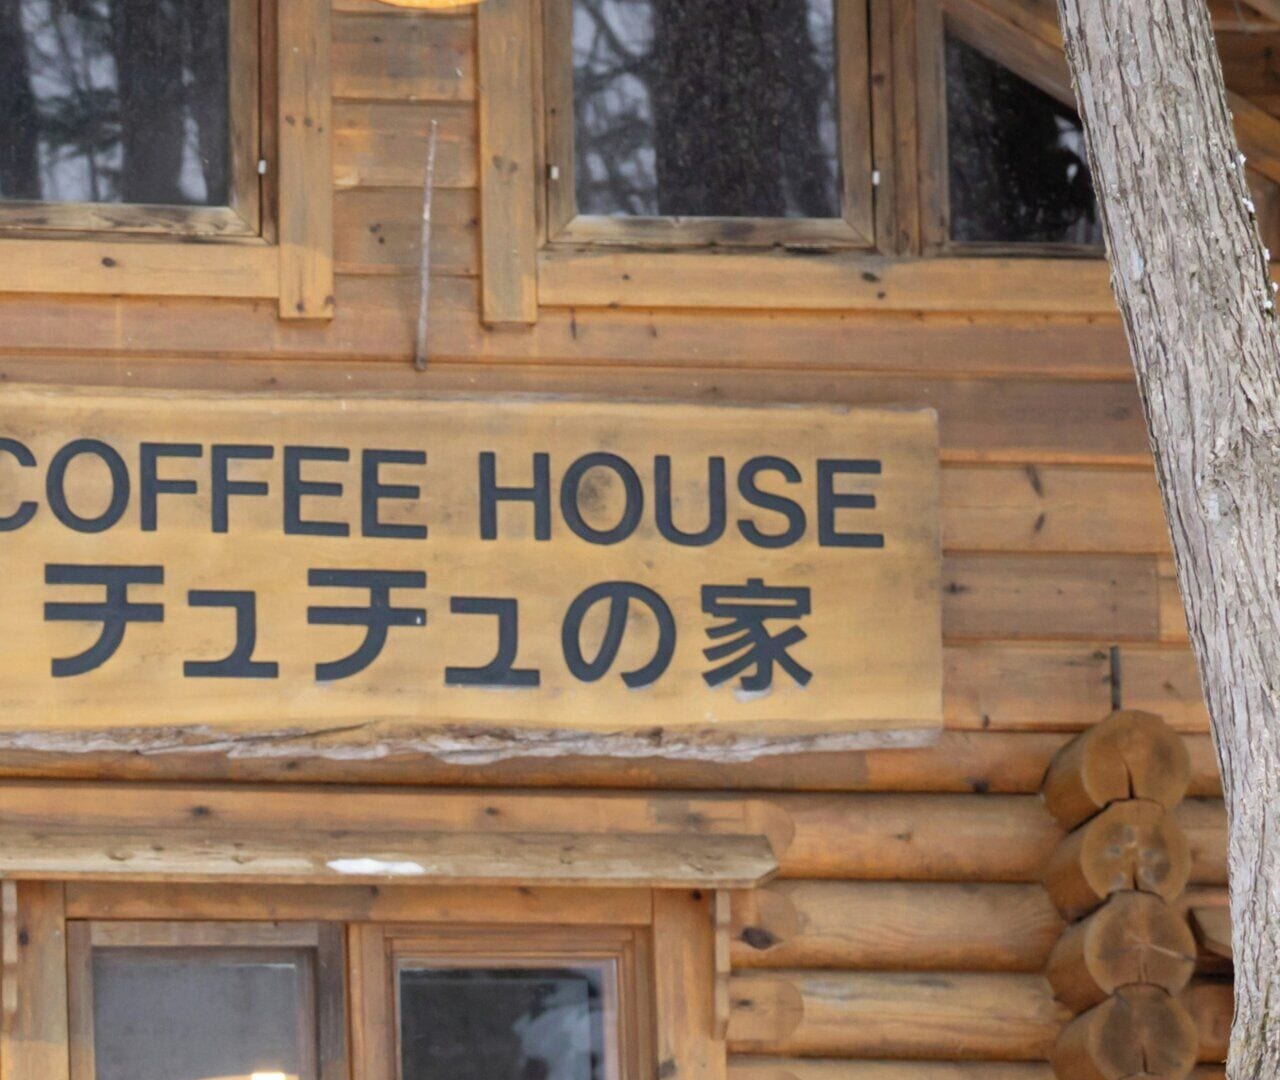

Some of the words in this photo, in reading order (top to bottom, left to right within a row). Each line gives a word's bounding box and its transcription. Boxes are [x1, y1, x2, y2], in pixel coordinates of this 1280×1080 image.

[479, 451, 885, 549] HOUSE
[43, 562, 814, 692] チュチュの家
